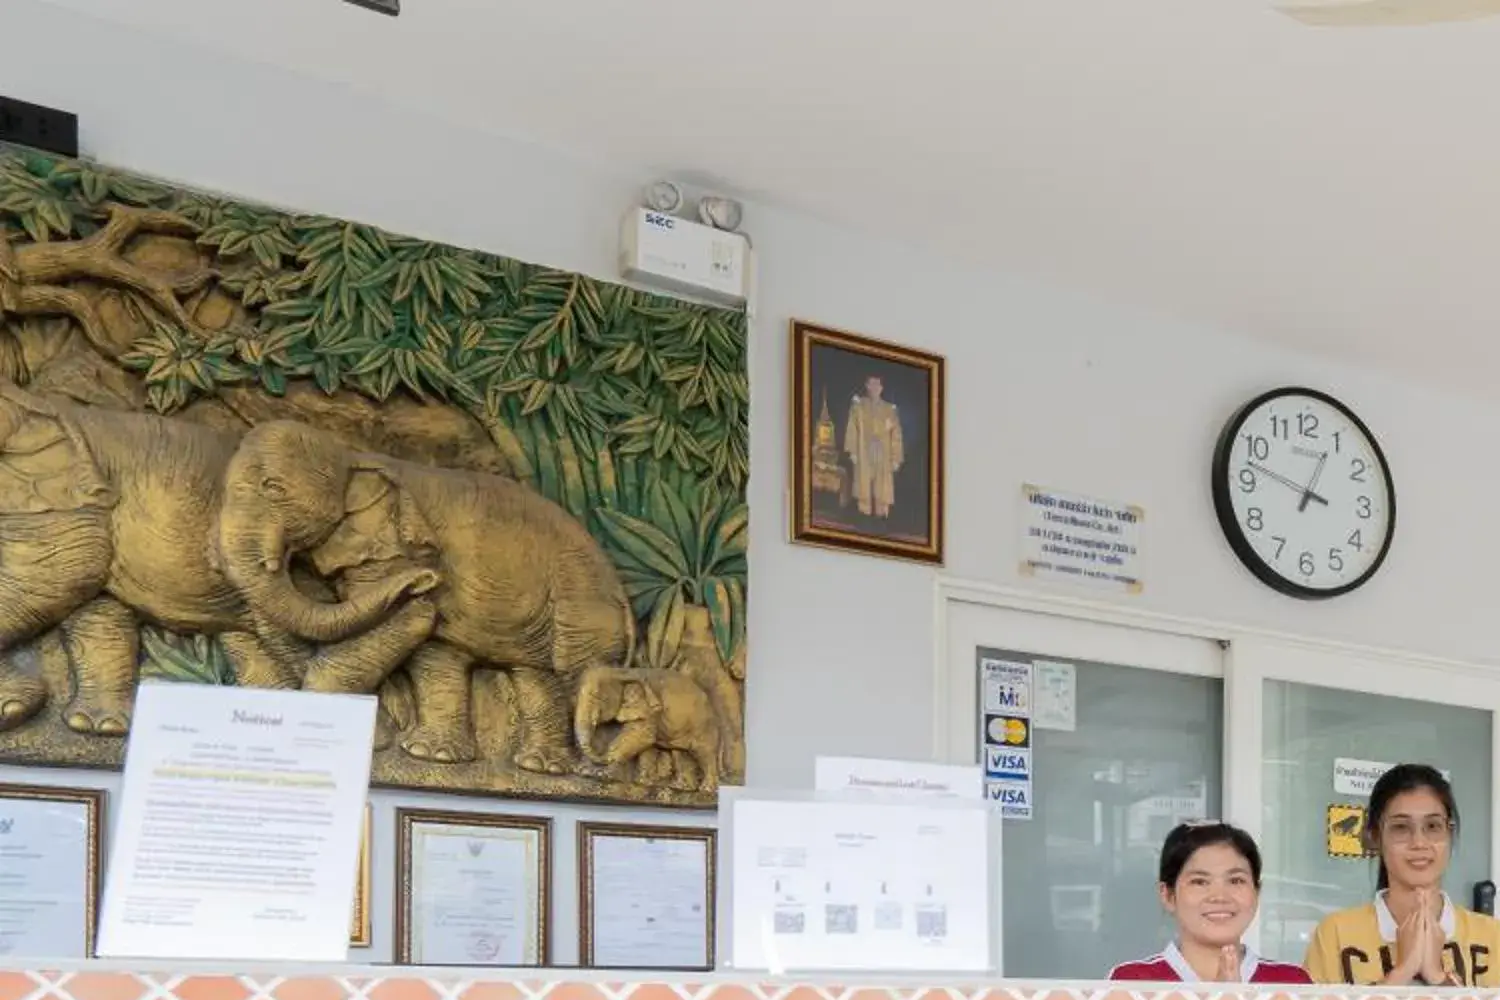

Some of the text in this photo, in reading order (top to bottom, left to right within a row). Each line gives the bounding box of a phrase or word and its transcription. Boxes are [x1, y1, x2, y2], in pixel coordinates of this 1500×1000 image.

[1269, 415, 1288, 440] 11
[1296, 413, 1319, 438] 12
[1246, 435, 1269, 460] 10
[1332, 431, 1340, 453] 1
[1239, 468, 1256, 493] 9
[1350, 458, 1366, 482] 2
[1247, 507, 1263, 531] 8
[1356, 496, 1371, 519] 3
[1272, 536, 1286, 560] 7
[1347, 529, 1363, 552] 4
[1299, 552, 1315, 576] 6
[1328, 548, 1343, 571] 5
[992, 755, 1026, 770] VISA
[992, 789, 1026, 805] VISA
